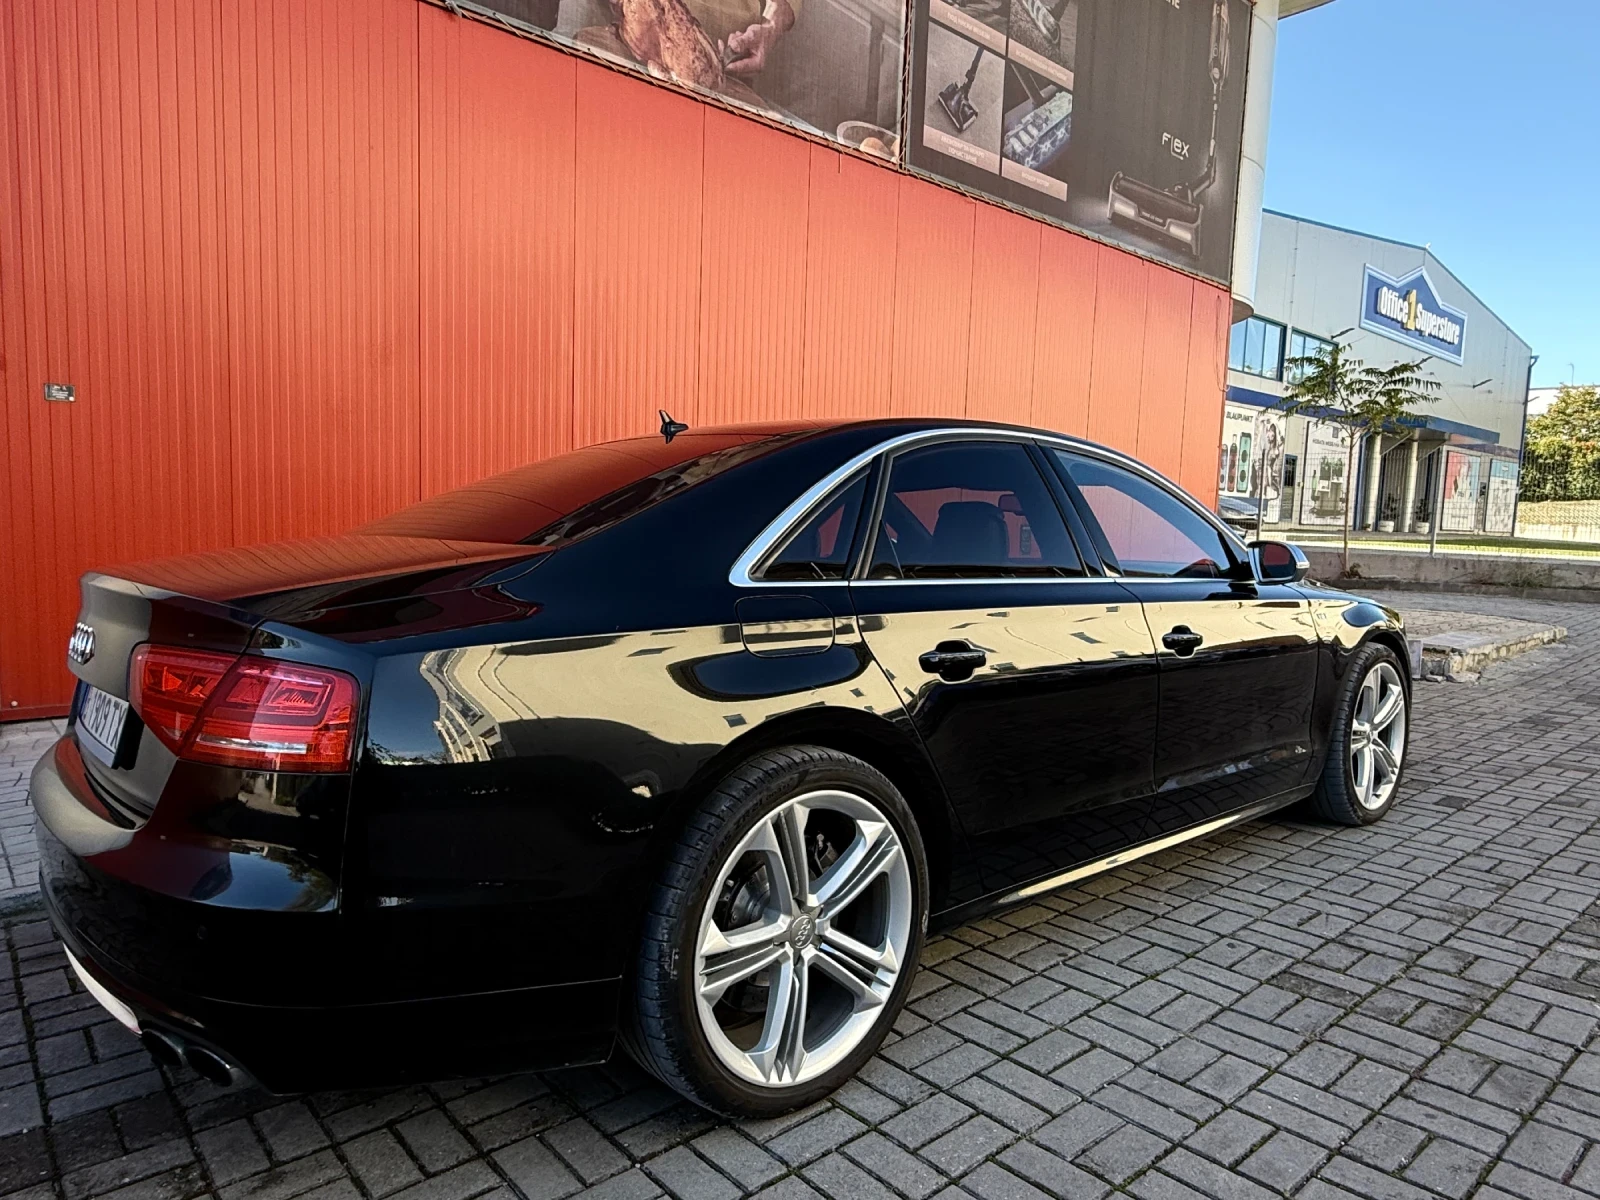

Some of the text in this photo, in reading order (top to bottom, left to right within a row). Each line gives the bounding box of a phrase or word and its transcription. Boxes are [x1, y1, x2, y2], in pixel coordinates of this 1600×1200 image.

[1378, 286, 1460, 345] Office 1 Superstore
